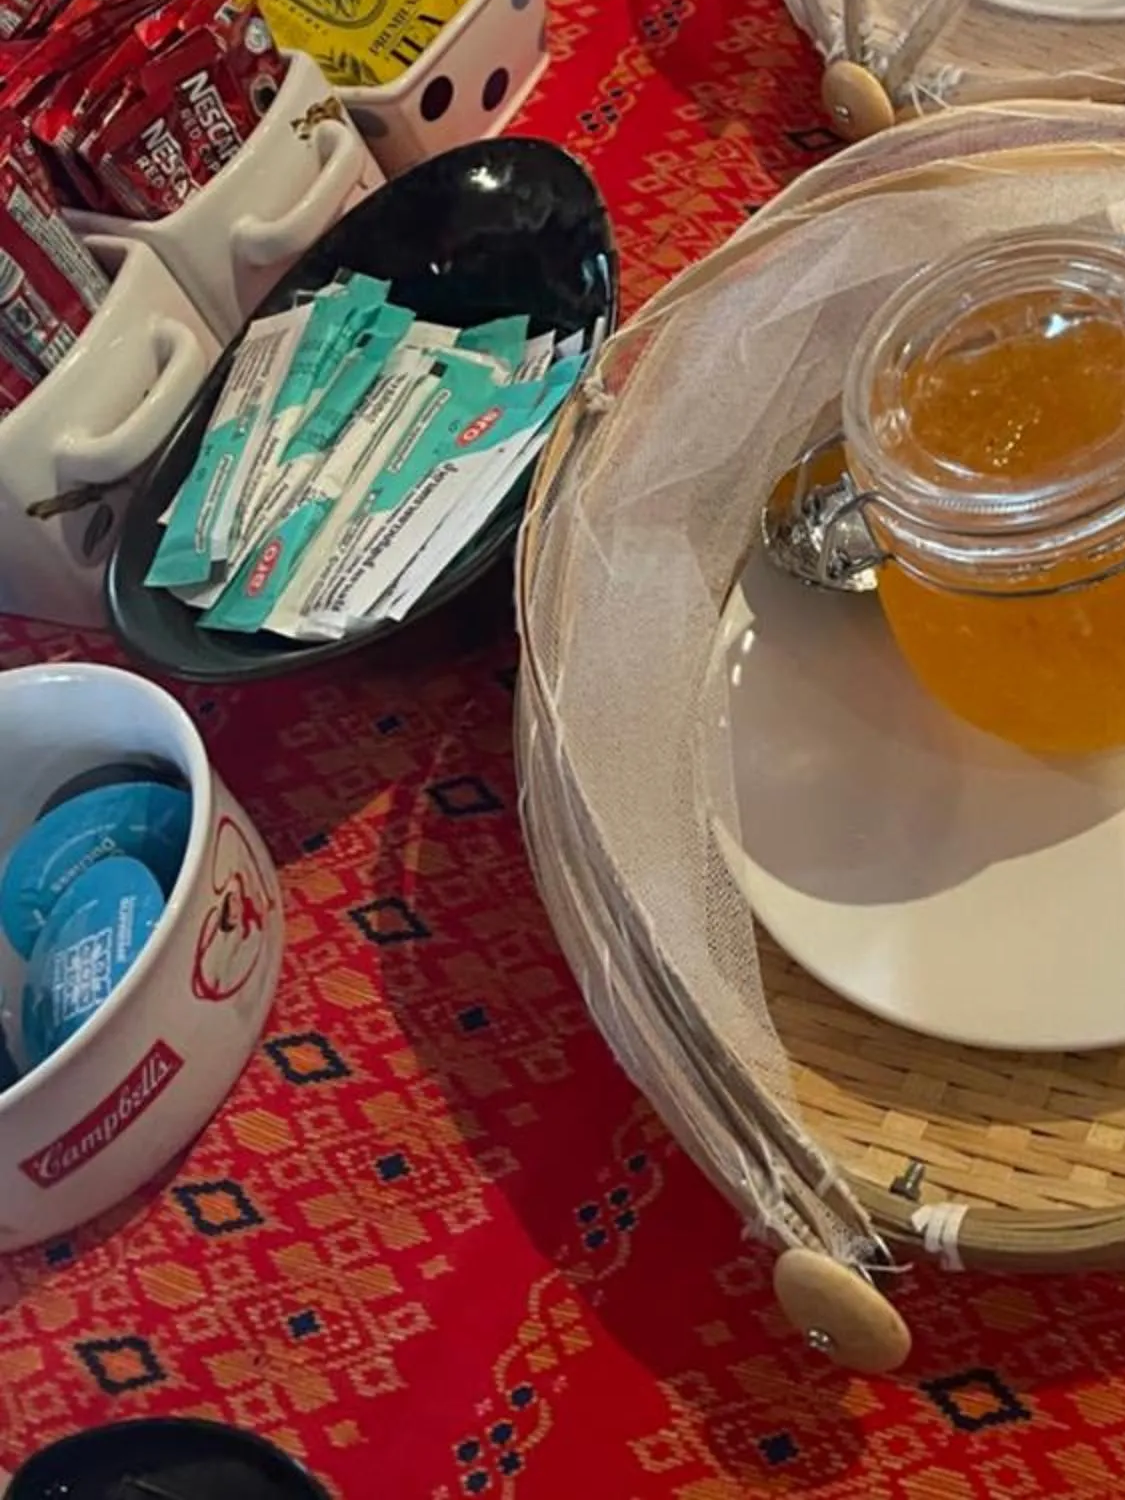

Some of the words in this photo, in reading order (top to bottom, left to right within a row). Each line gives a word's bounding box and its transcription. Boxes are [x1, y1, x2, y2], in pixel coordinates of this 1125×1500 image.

[386, 13, 446, 67] TEA
[180, 107, 202, 140] RED
[135, 155, 165, 189] RED
[249, 544, 279, 591] aro
[33, 1051, 172, 1178] Campbell's
